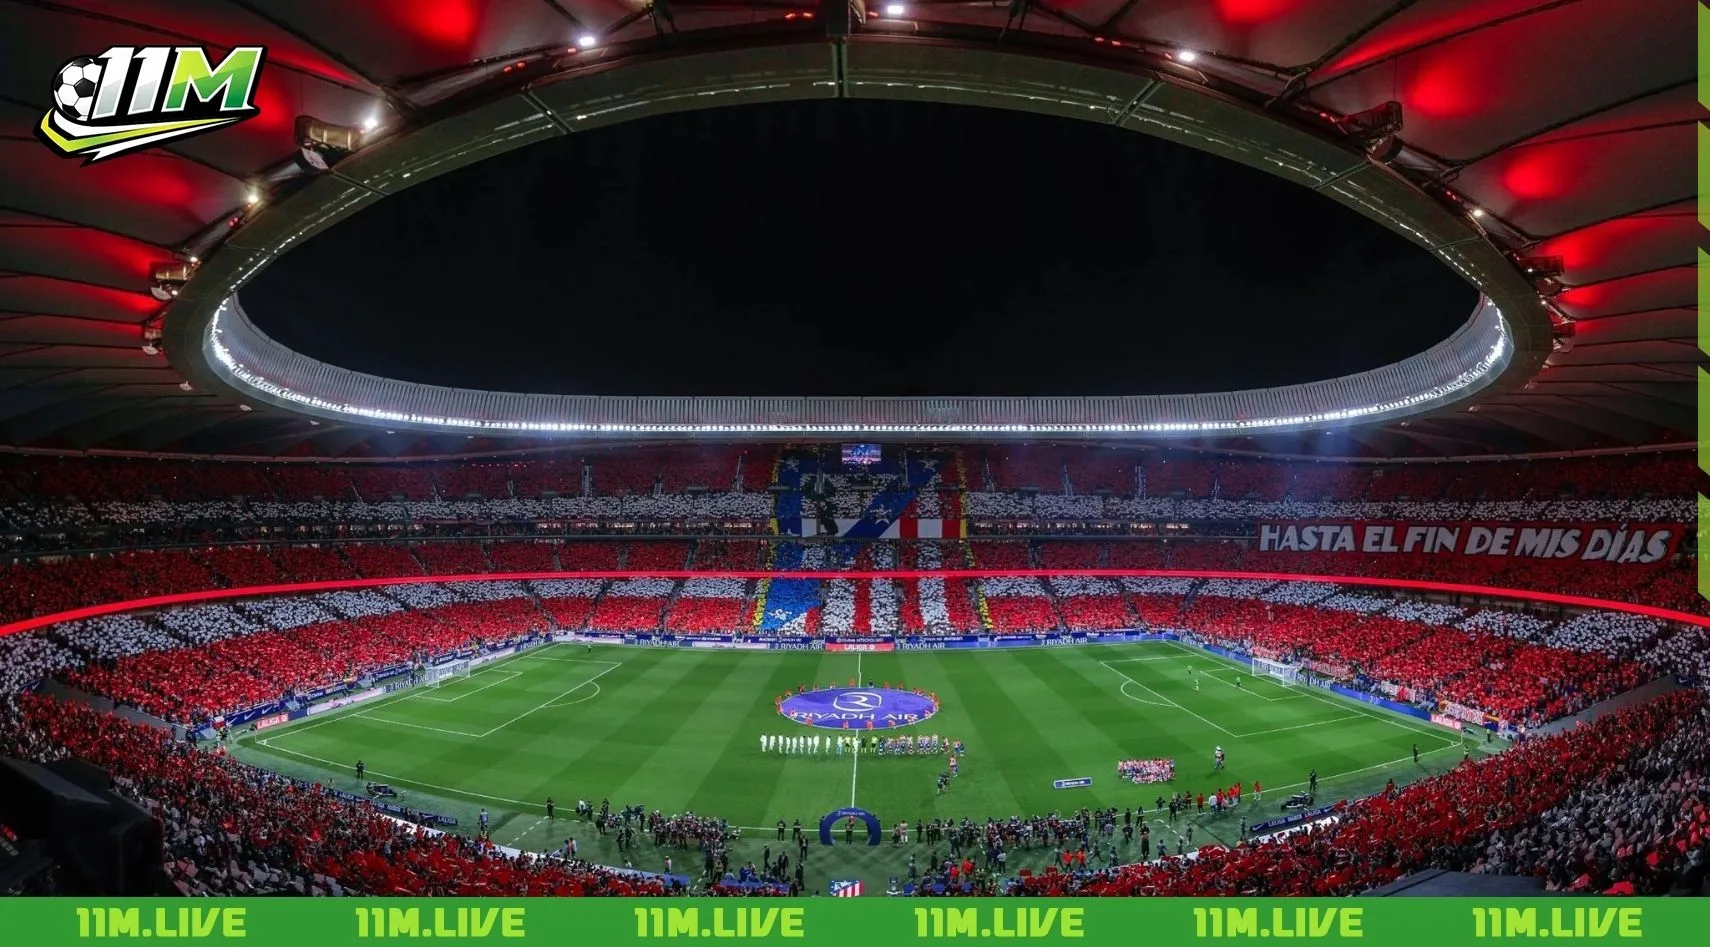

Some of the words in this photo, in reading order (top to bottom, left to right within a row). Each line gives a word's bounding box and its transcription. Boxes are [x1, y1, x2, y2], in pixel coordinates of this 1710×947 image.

[1259, 525, 1355, 552] HASTA
[1363, 526, 1398, 553] EL
[1403, 526, 1460, 553] FIN
[1464, 527, 1515, 555] DE
[1514, 528, 1582, 558] MIS
[1581, 523, 1673, 563] DÍAS
[781, 642, 809, 650] RIYADH
[811, 642, 823, 650] AIR
[795, 712, 875, 720] RIYADH
[257, 717, 280, 728] LALIGA
